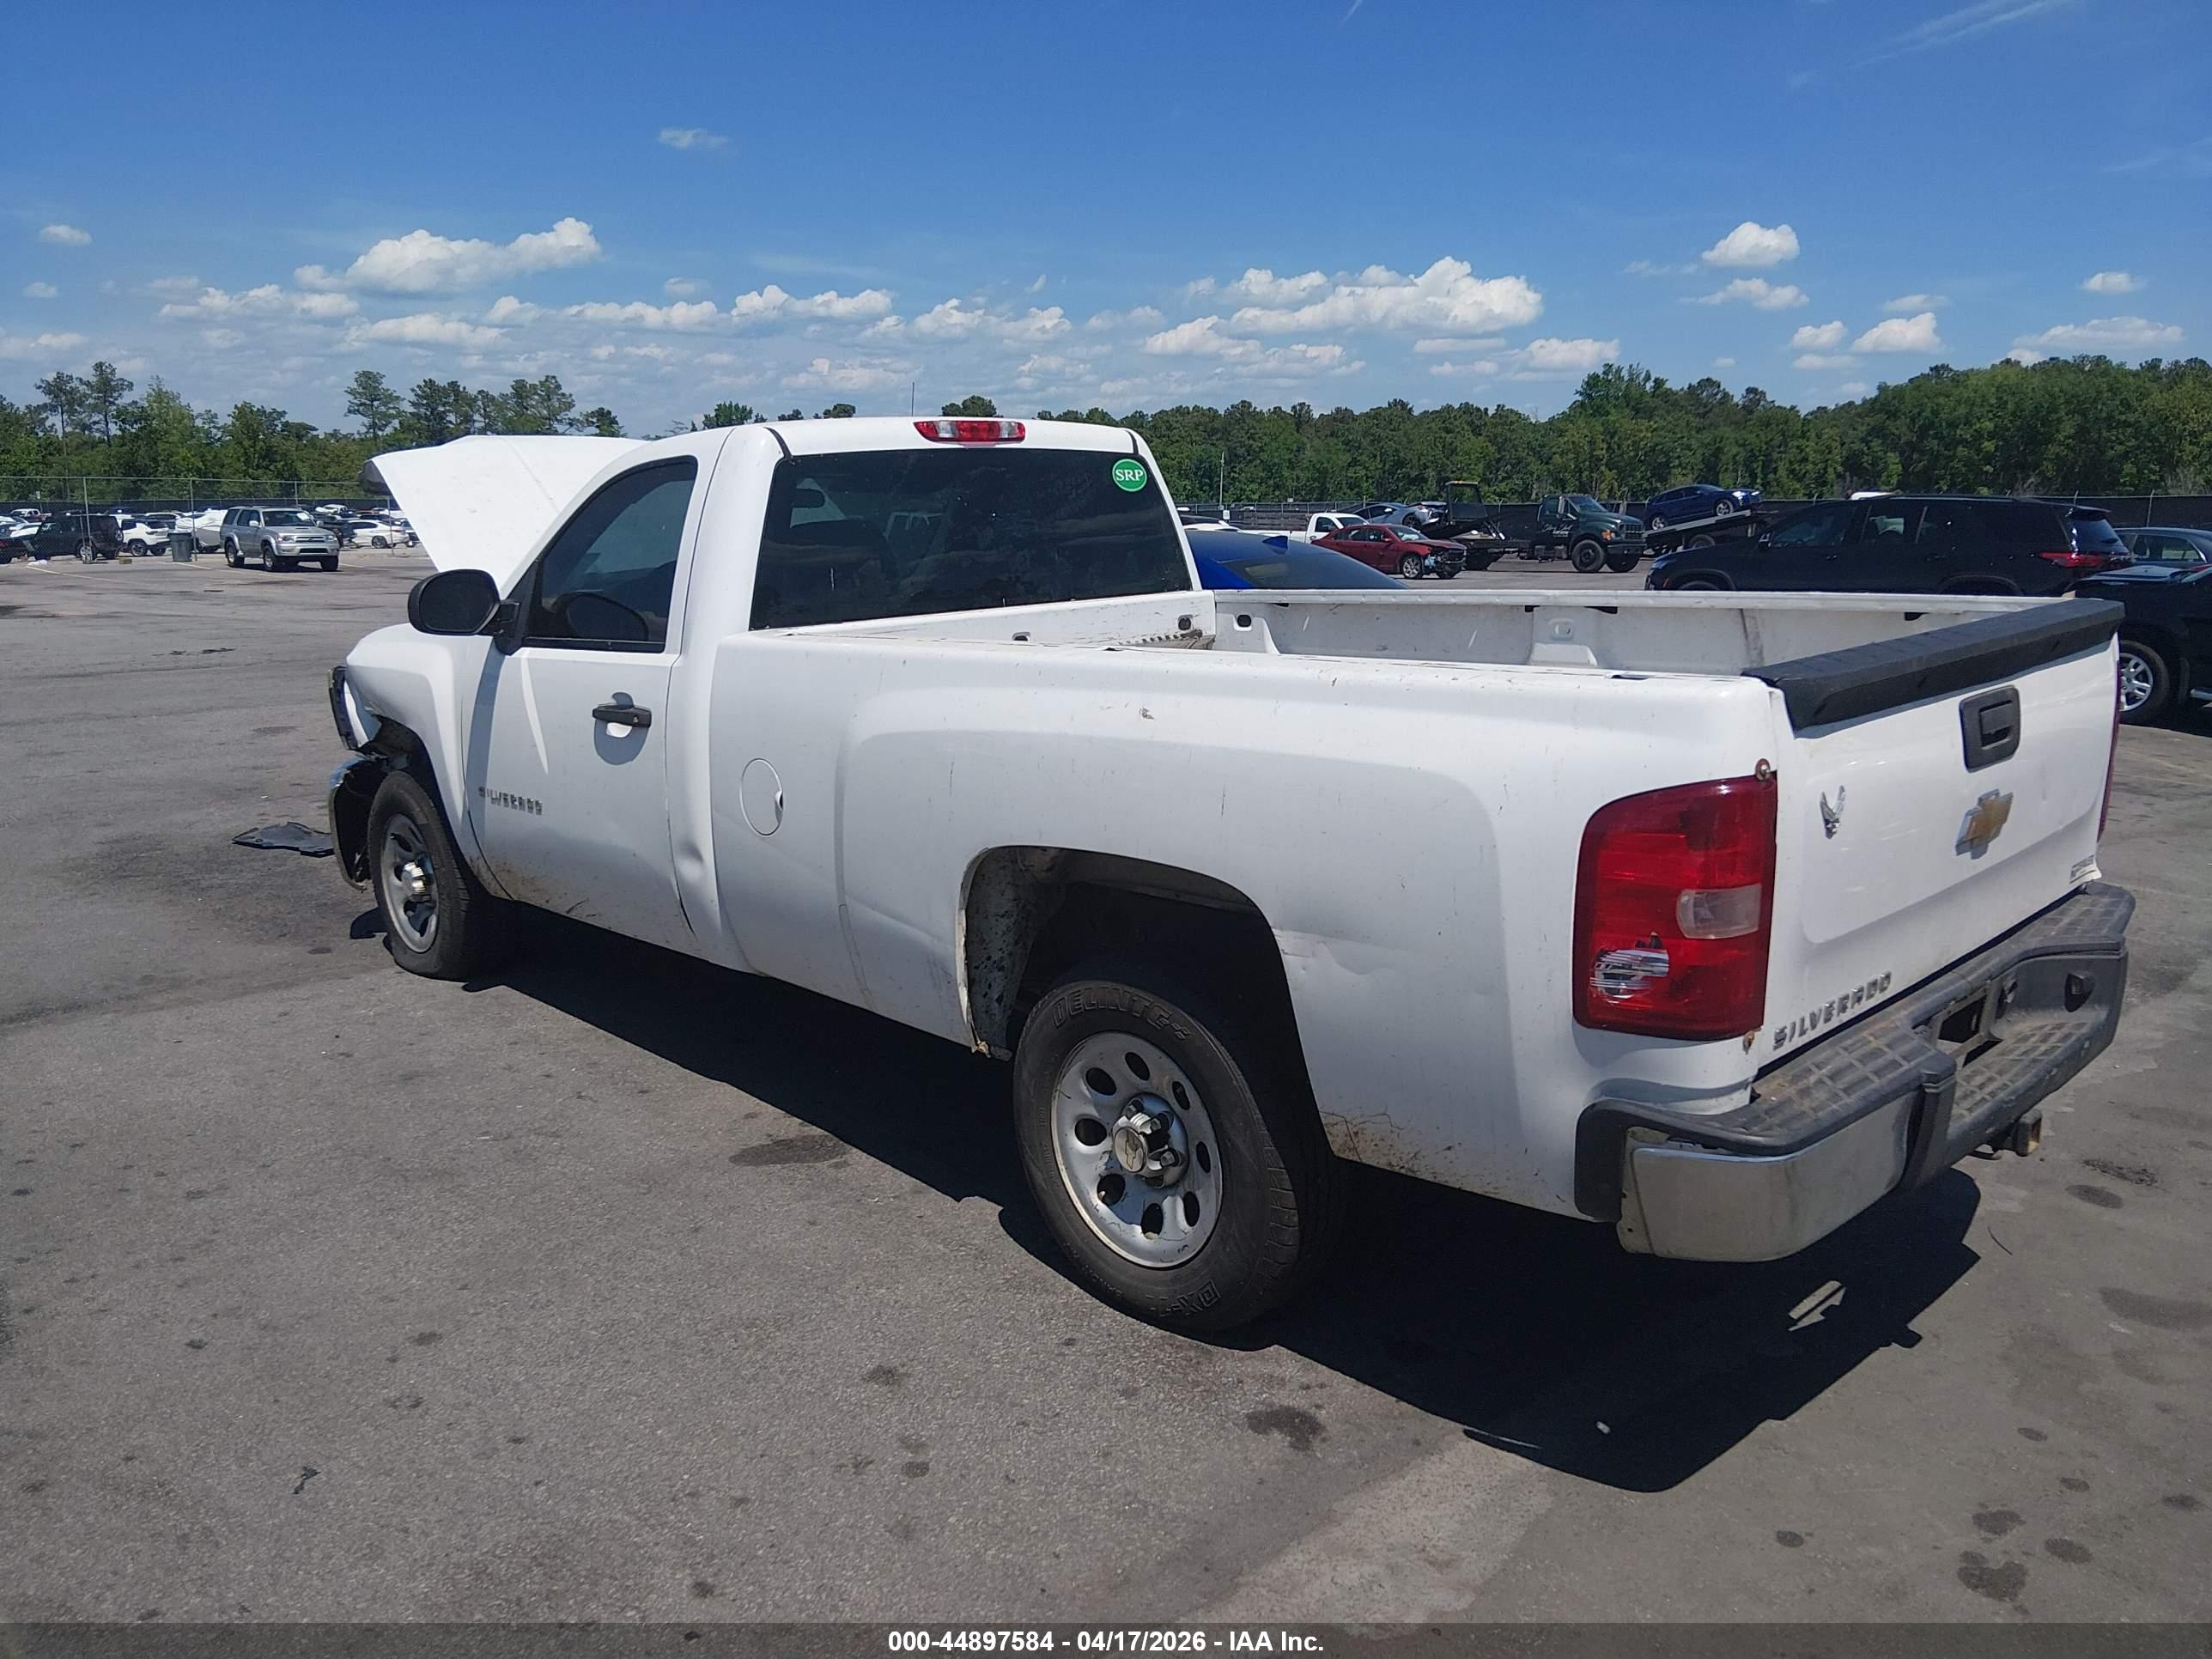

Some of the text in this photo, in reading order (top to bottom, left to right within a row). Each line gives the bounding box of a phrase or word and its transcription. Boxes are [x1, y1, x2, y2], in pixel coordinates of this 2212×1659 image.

[1115, 469, 1144, 482] SRP
[478, 786, 543, 815] SILVERADO
[1772, 972, 1892, 1051] SILVERADO
